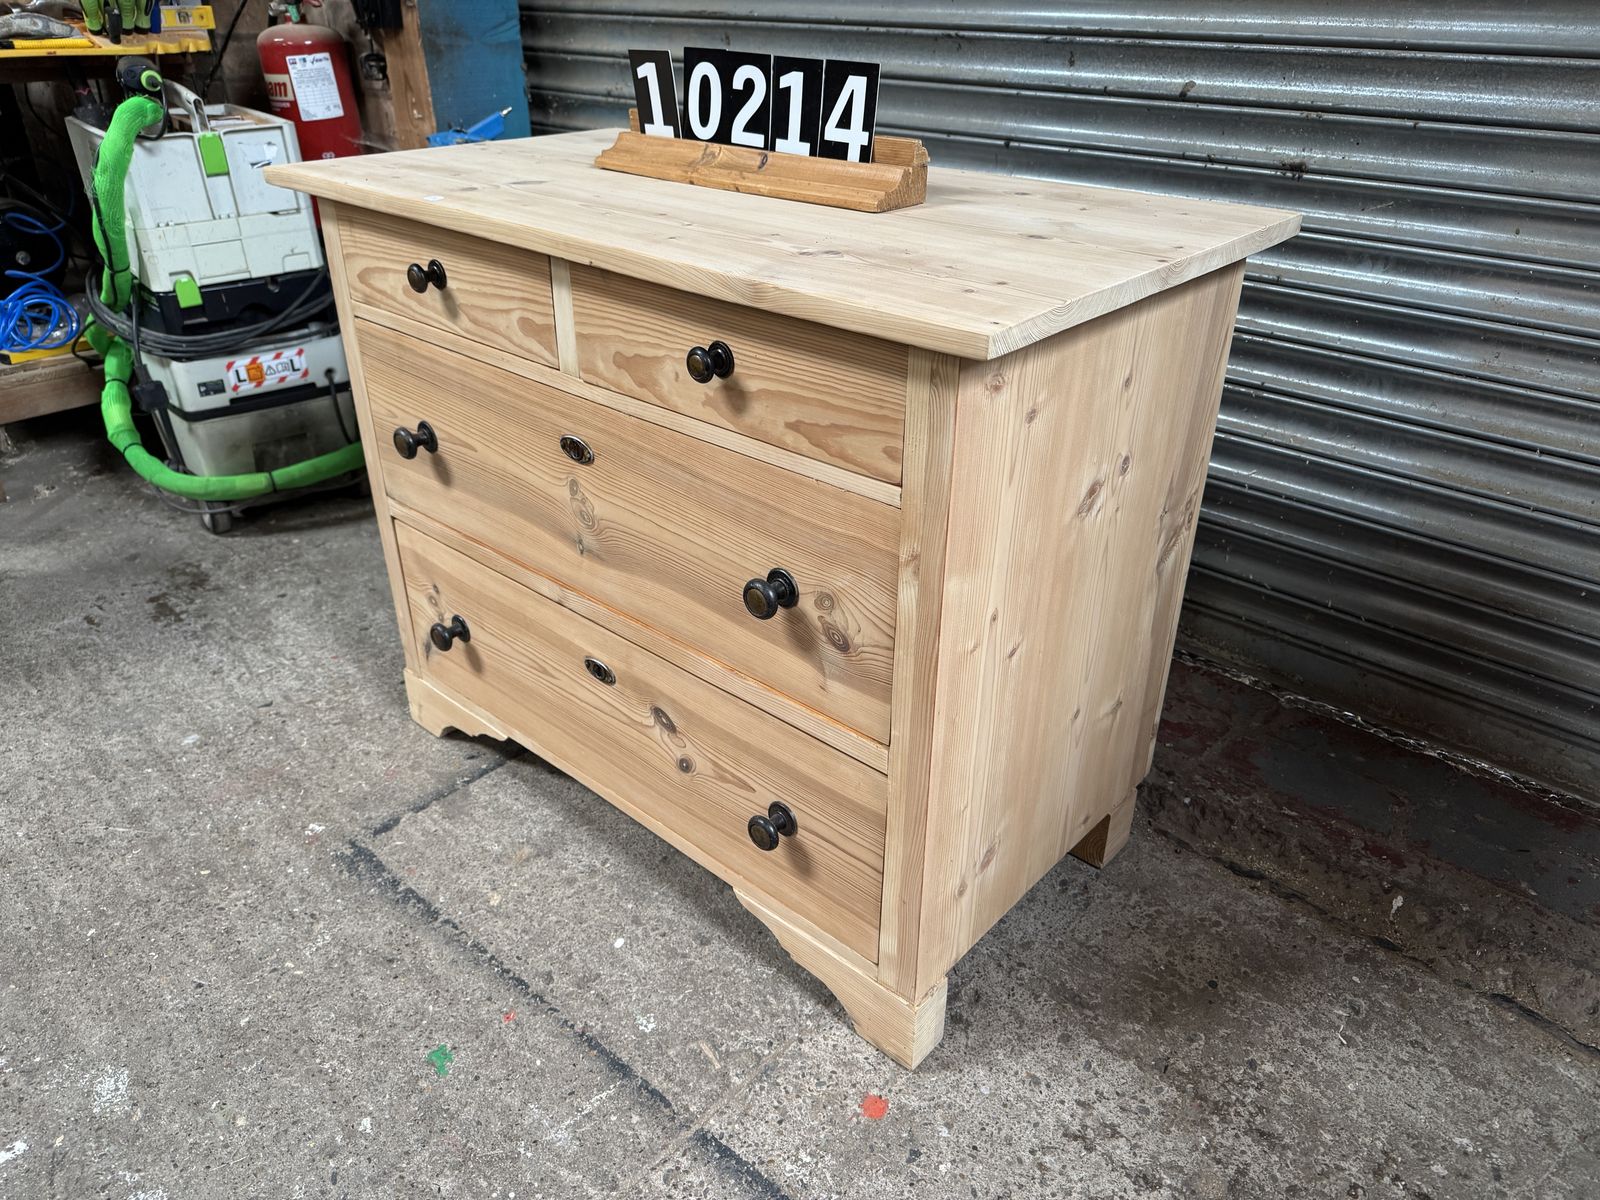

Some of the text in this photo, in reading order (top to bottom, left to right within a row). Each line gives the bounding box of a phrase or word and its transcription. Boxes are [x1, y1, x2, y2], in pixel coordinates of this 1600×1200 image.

[636, 61, 869, 162] 10214
[236, 359, 301, 382] L L
